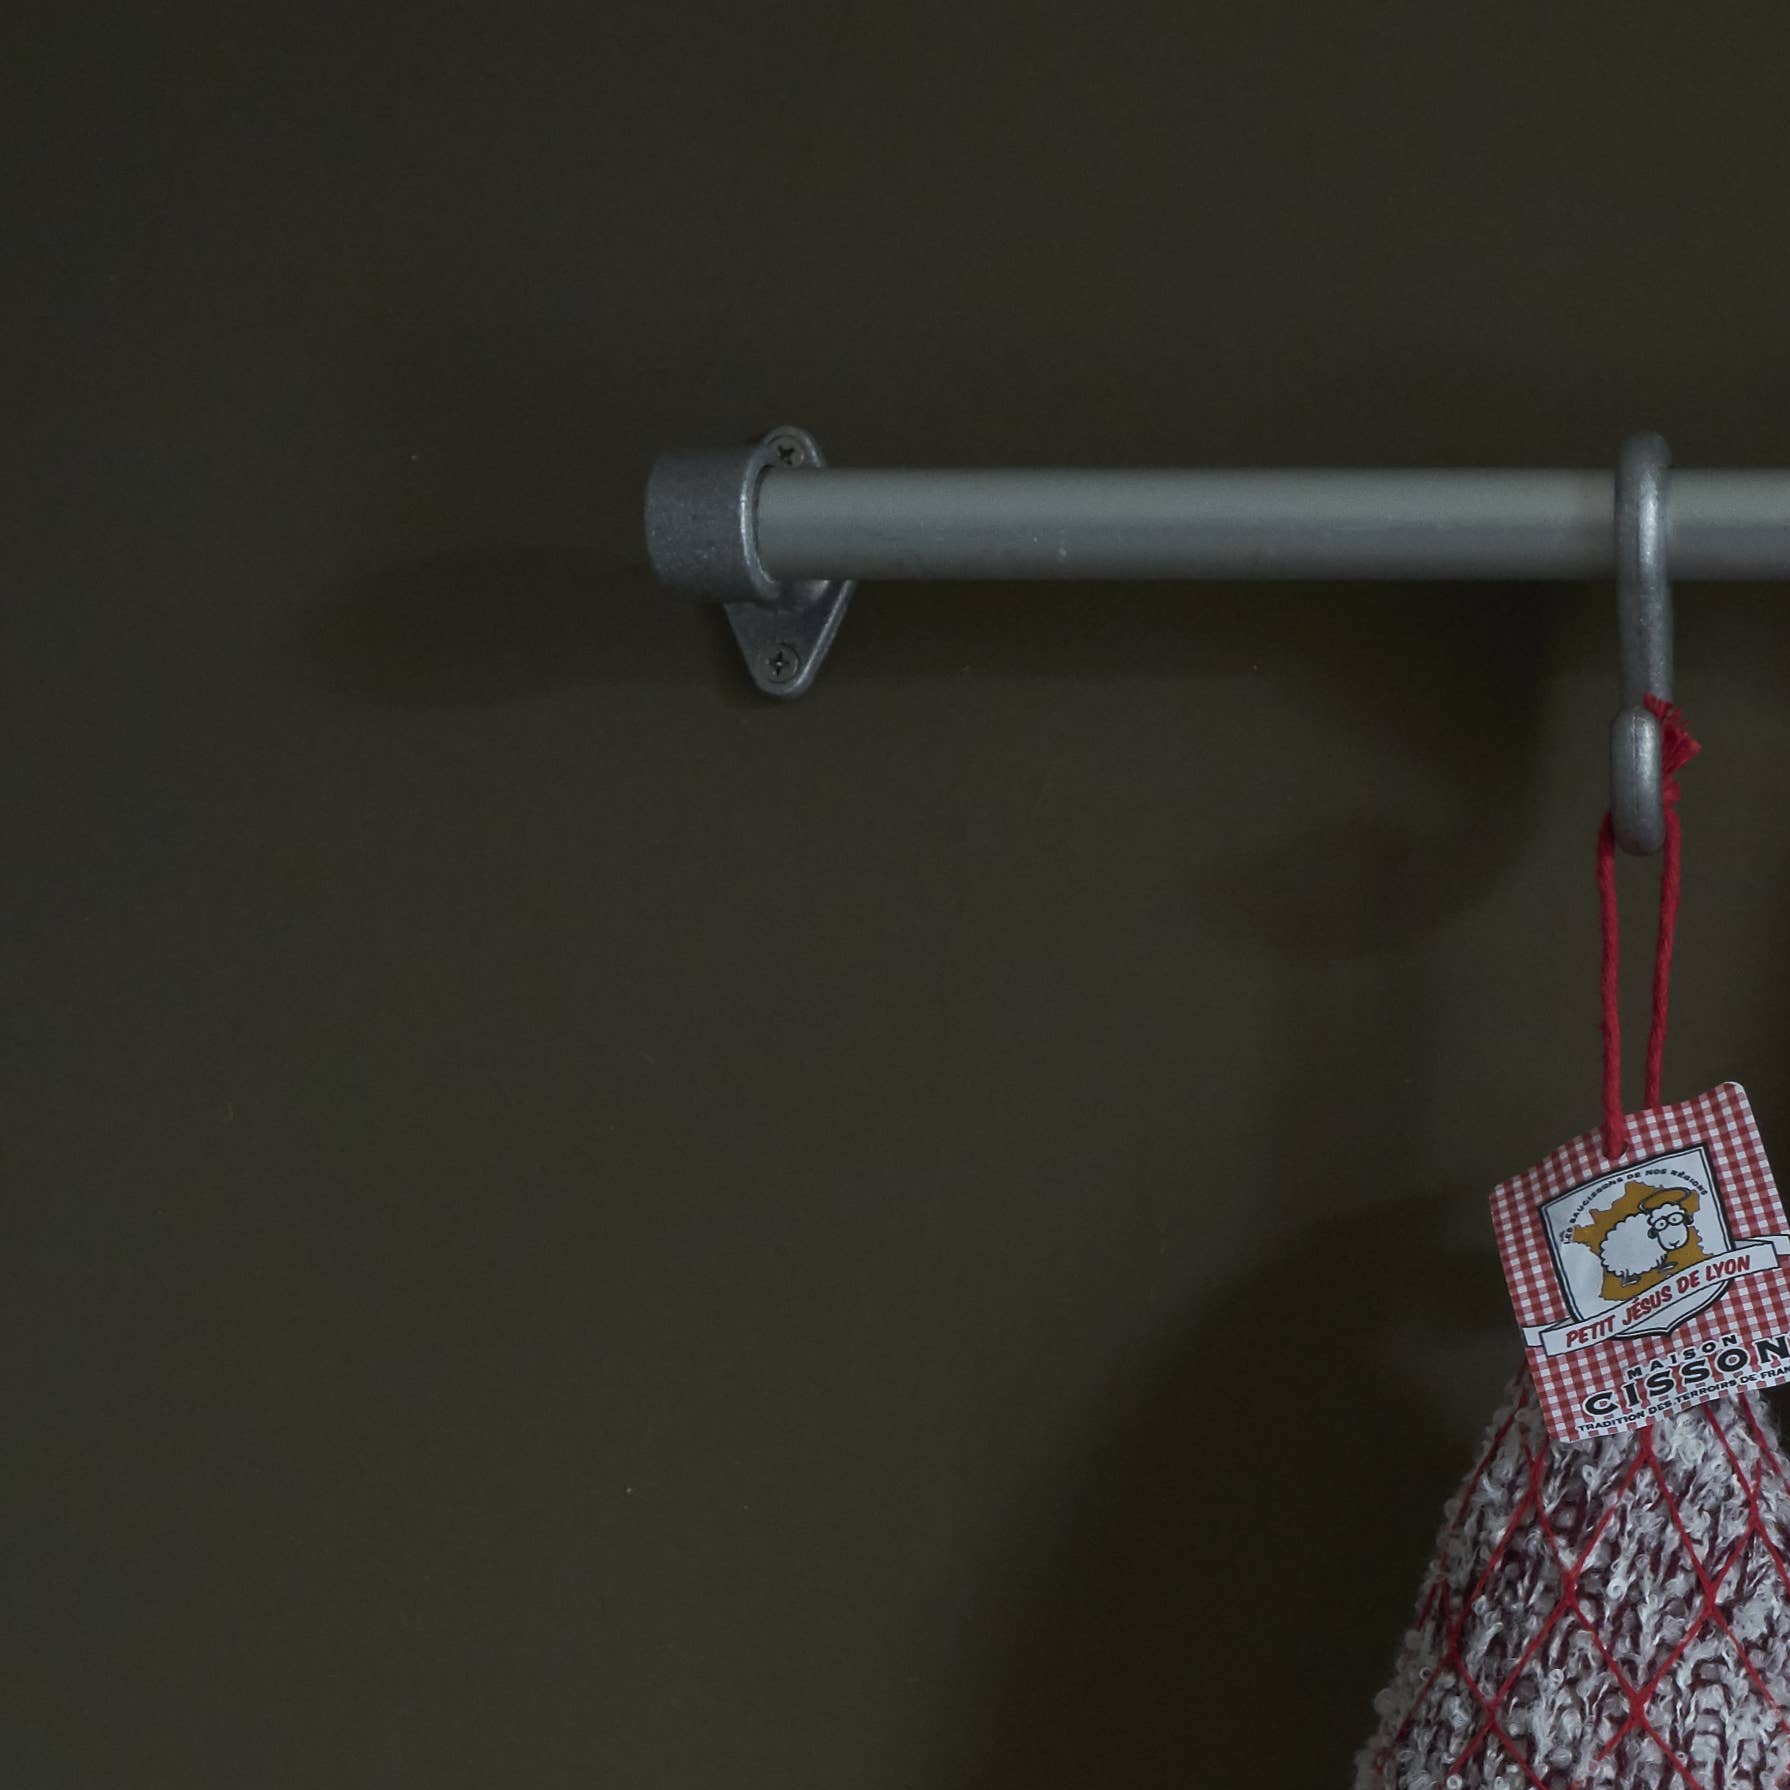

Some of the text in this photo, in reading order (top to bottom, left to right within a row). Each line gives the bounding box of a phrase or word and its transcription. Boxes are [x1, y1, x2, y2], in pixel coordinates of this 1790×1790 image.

[1569, 1176, 1624, 1224] SAUCISSONS
[1626, 1171, 1641, 1181] DE
[1644, 1168, 1667, 1176] NOS
[1670, 1169, 1708, 1196] RÉGIONS
[1566, 1254, 1751, 1348] PETIT JÉSUS DE LYON
[1626, 1333, 1739, 1381] MAISON
[1577, 1409, 1646, 1432] TRADITION
[1647, 1400, 1672, 1415] DES
[1676, 1378, 1737, 1403] TERROIRS
[1740, 1373, 1758, 1385] DE
